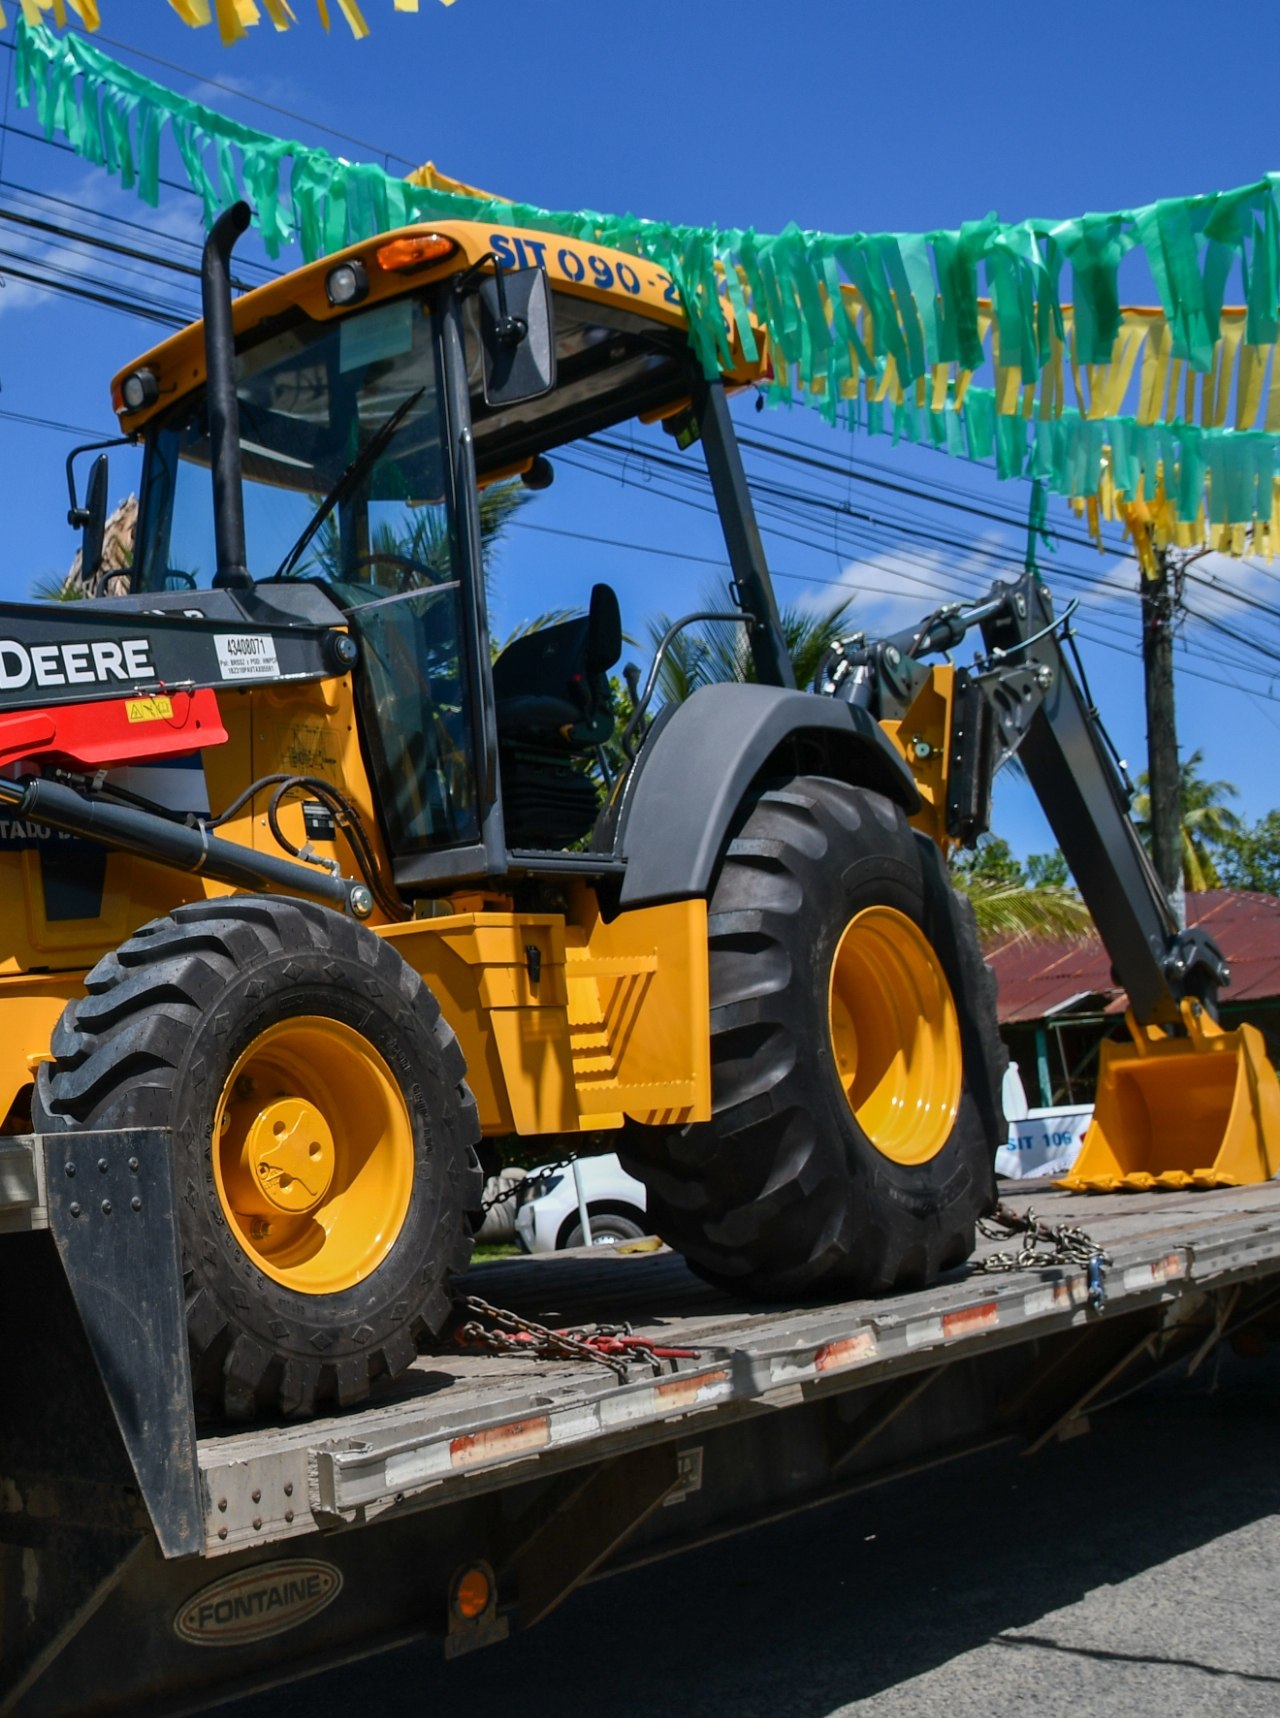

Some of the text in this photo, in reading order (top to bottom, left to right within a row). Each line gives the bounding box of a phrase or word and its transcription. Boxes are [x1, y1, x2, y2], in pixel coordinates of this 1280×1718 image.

[489, 234, 547, 269] SIT
[227, 638, 266, 656] 43408071
[1006, 1132, 1072, 1151] SIT 106
[198, 1574, 321, 1628] FONTAINE
